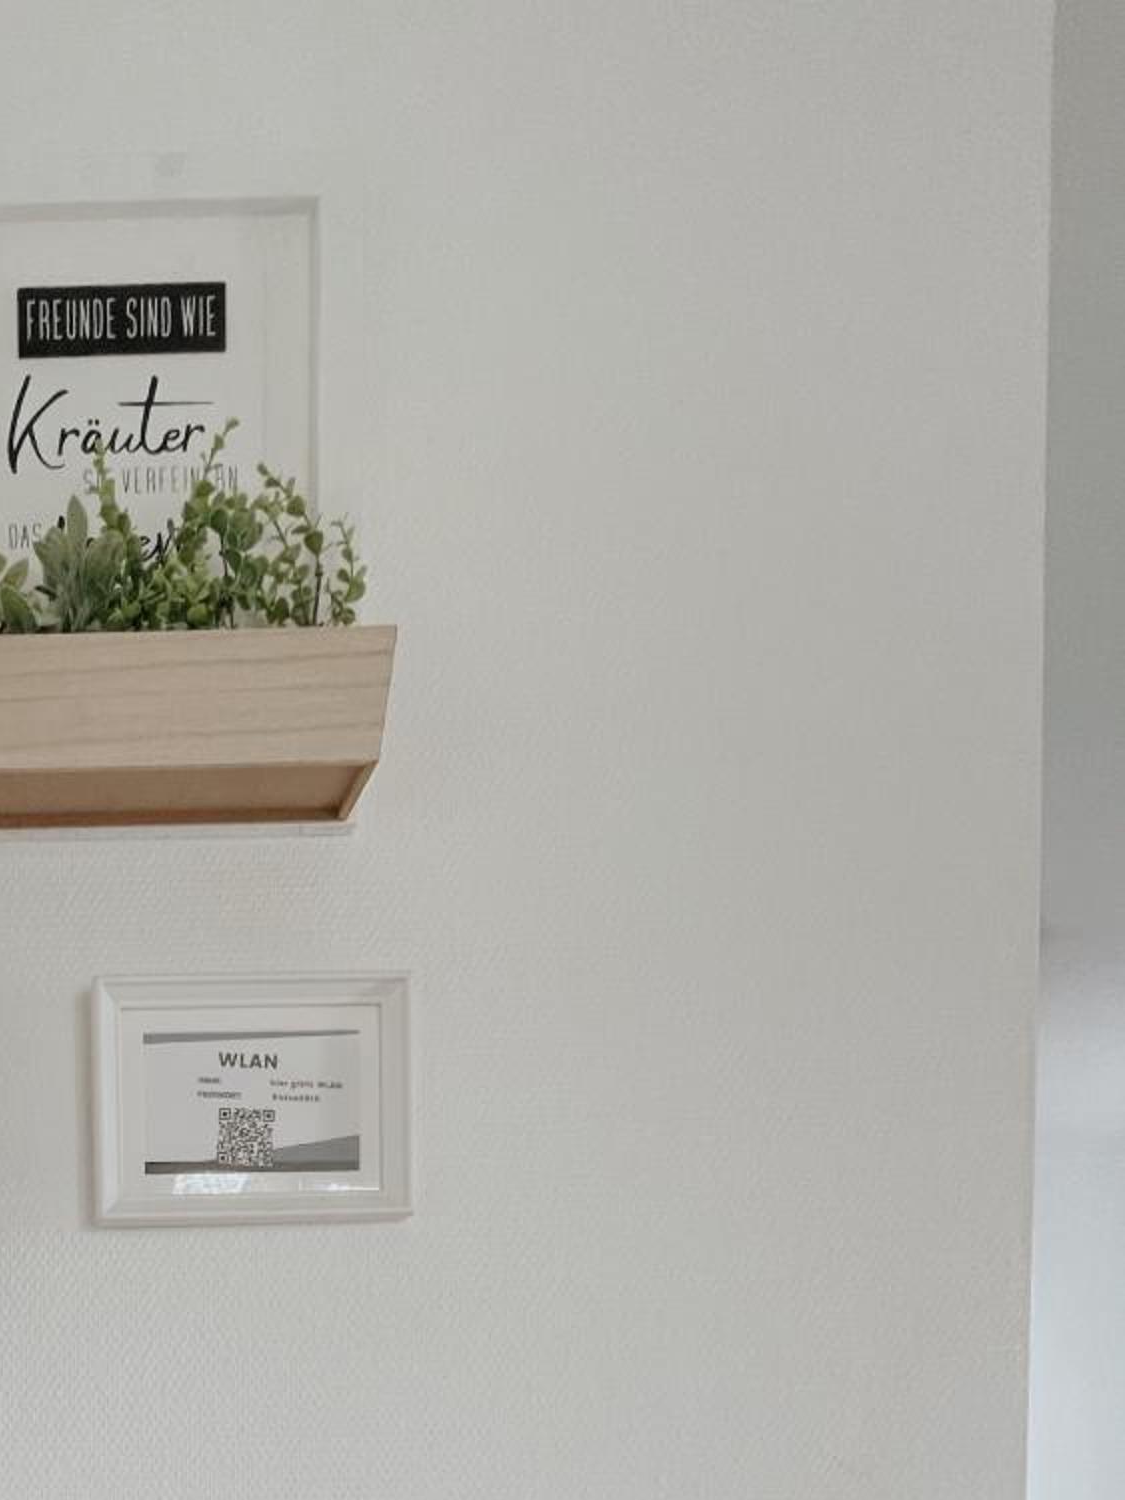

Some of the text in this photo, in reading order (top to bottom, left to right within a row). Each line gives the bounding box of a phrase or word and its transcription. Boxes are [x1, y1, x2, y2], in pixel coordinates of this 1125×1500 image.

[26, 294, 216, 341] FREUNDE SIND WIE
[7, 373, 214, 475] Kräuter
[218, 1052, 278, 1069] WLAN
